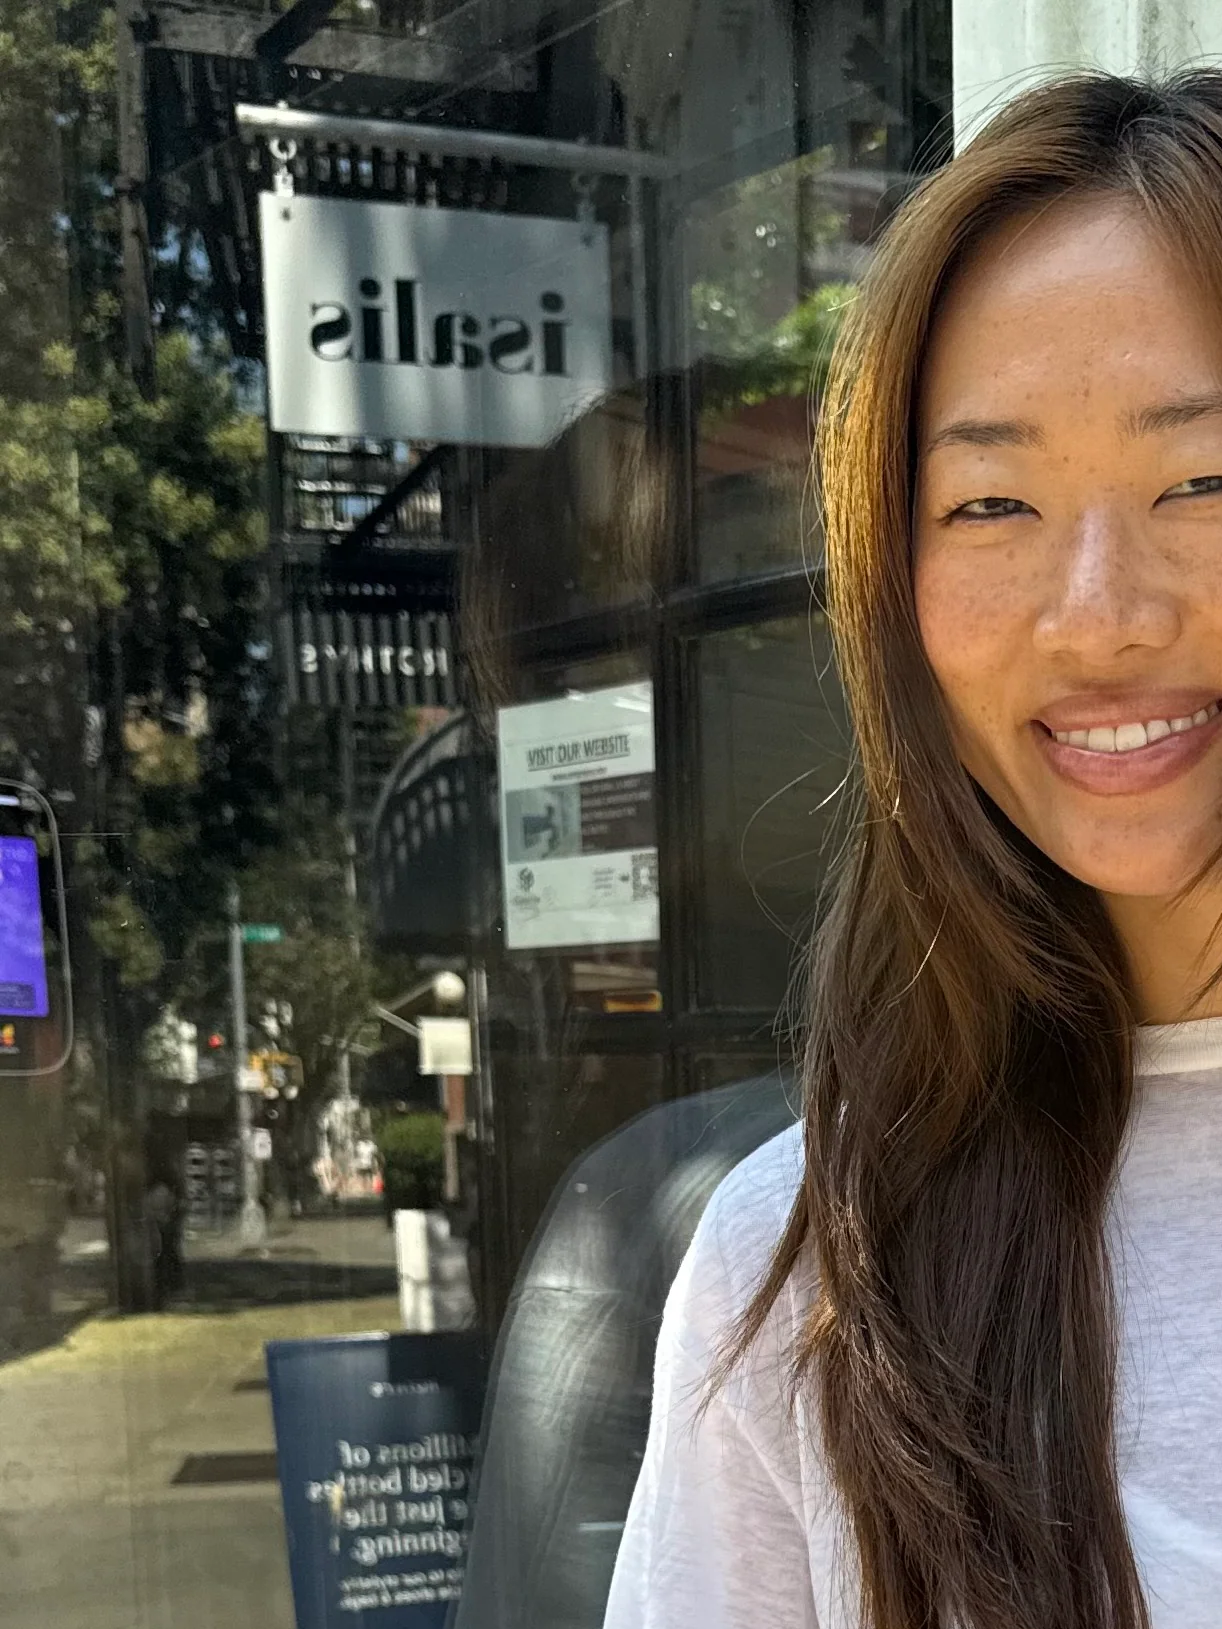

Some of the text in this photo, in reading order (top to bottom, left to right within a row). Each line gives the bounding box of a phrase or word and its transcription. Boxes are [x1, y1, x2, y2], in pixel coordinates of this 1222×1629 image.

[527, 734, 630, 767] VISIT OUR WEBSITE
